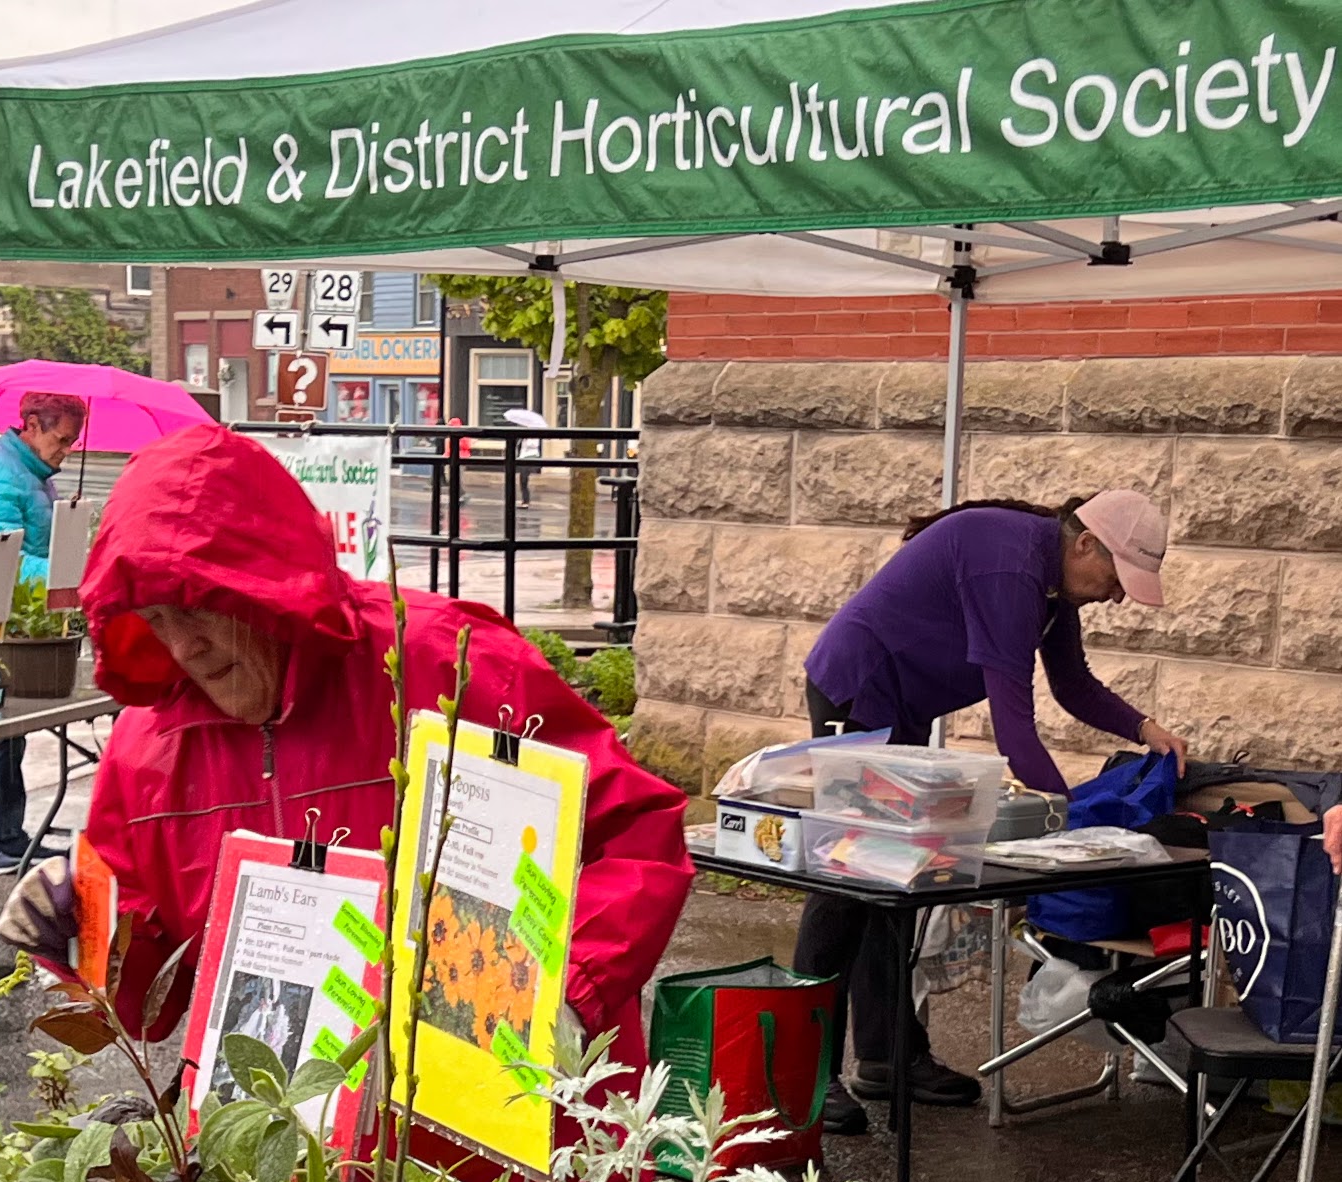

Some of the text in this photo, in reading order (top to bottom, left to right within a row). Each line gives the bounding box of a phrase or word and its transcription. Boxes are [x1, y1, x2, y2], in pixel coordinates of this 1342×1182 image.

[28, 32, 1336, 210] Lakefield & District Horticultural Society
[268, 272, 293, 293] 29
[321, 274, 353, 301] 28
[248, 881, 318, 908] Lamb's Ears
